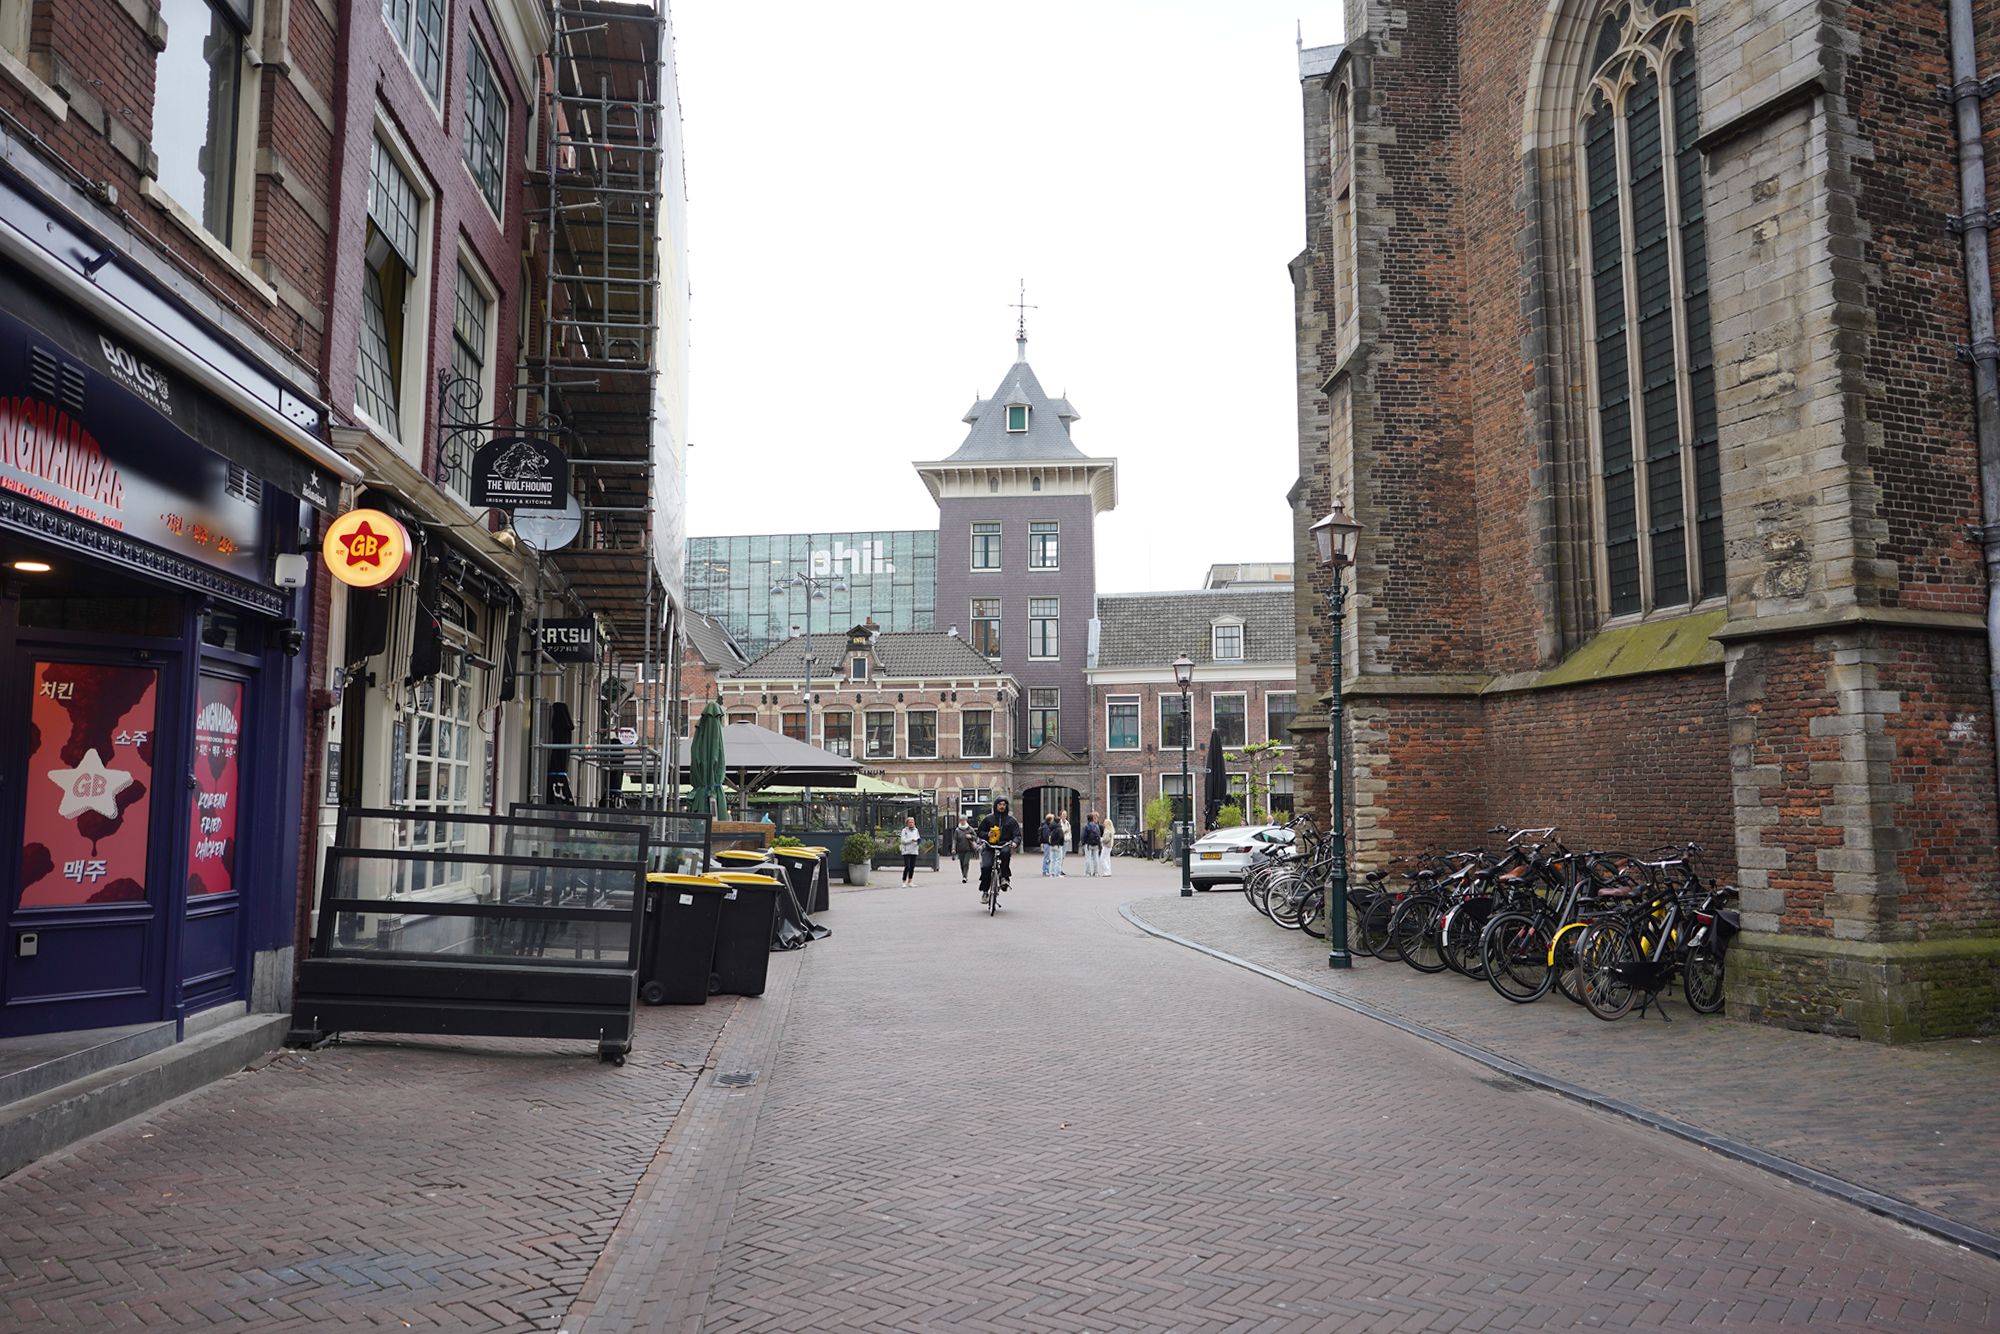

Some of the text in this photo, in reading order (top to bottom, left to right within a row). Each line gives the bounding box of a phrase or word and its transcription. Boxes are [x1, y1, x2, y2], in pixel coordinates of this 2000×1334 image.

[98, 334, 156, 391] BOLS
[487, 480, 553, 492] THE WOLFHOUND
[350, 534, 378, 557] GB
[807, 540, 896, 579] phil.
[39, 682, 74, 700] 치킨
[115, 730, 148, 747] 소주
[72, 772, 108, 798] GB
[197, 791, 228, 809] KOREAN
[200, 816, 222, 833] FRIED
[195, 837, 226, 862] CHICKEN
[63, 860, 107, 883] 맥주
